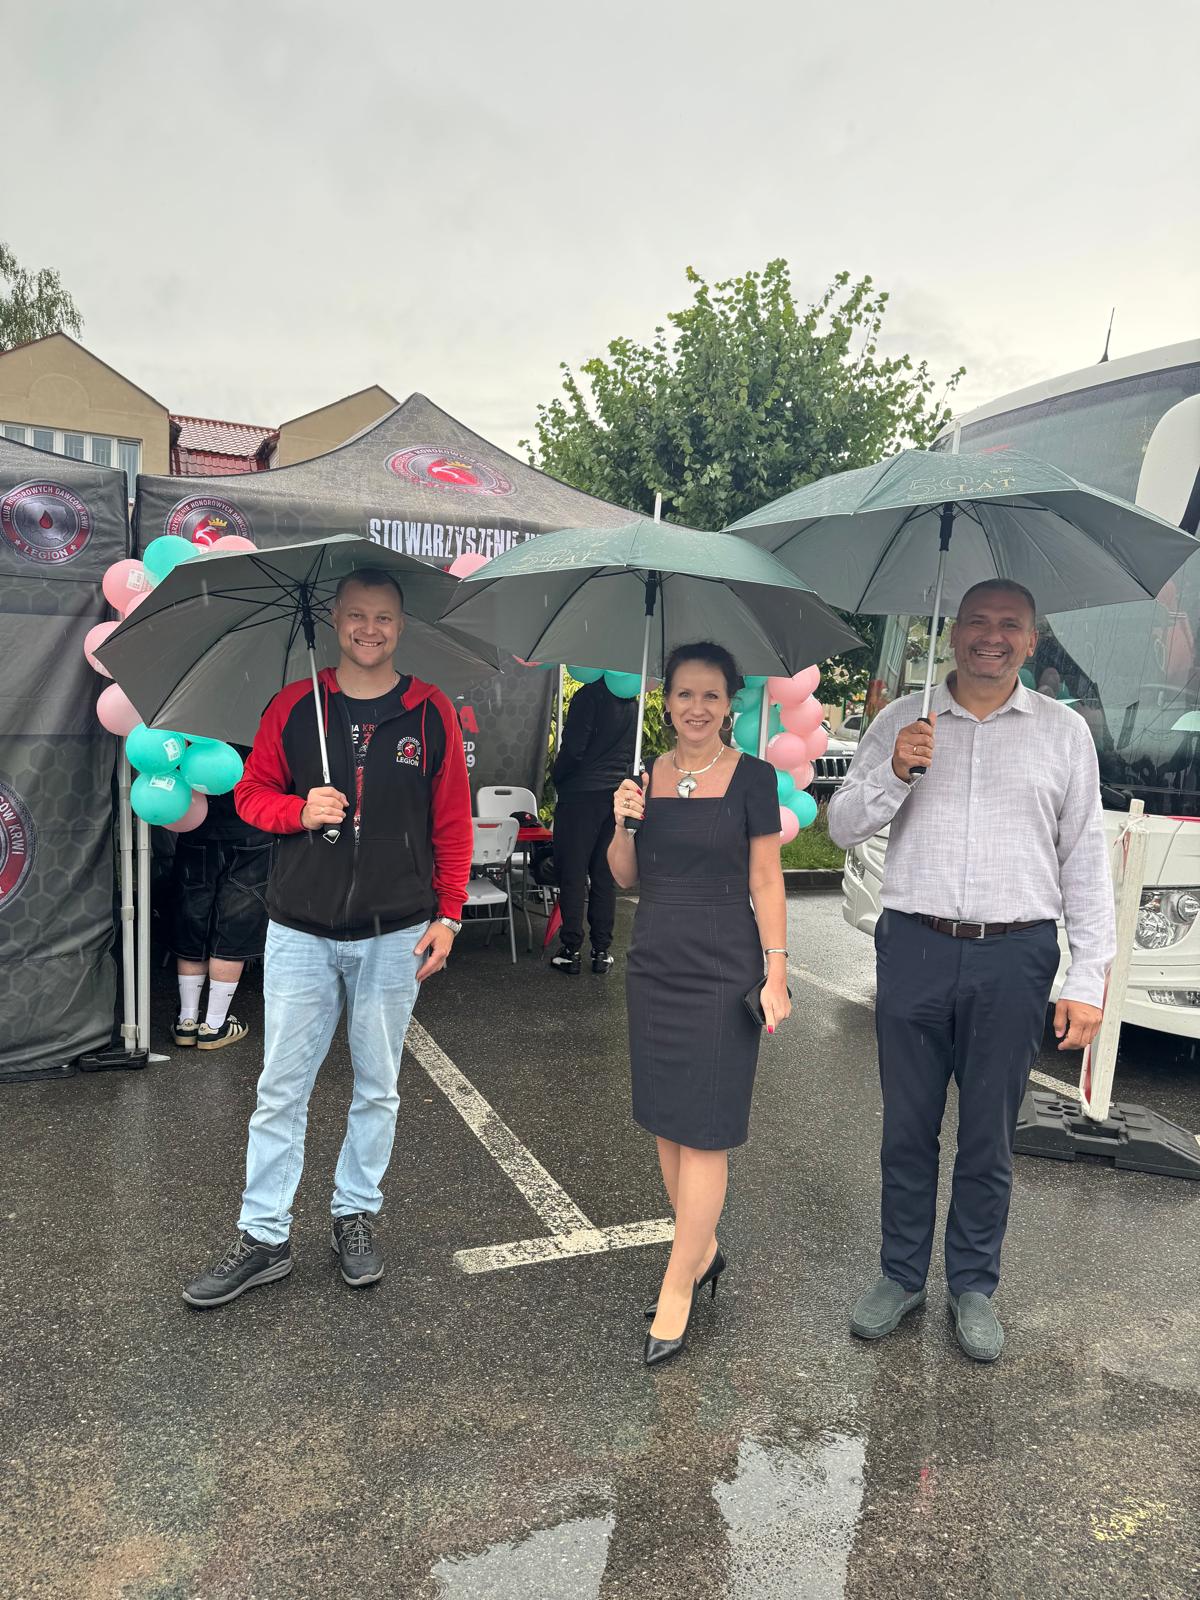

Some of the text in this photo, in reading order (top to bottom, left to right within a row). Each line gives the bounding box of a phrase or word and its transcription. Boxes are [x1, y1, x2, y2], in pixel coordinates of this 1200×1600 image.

[191, 499, 234, 515] HONOROWYCH
[79, 510, 89, 529] KRWI
[23, 545, 69, 560] LEGION
[396, 756, 419, 767] LEGION
[8, 823, 25, 855] KRWI
